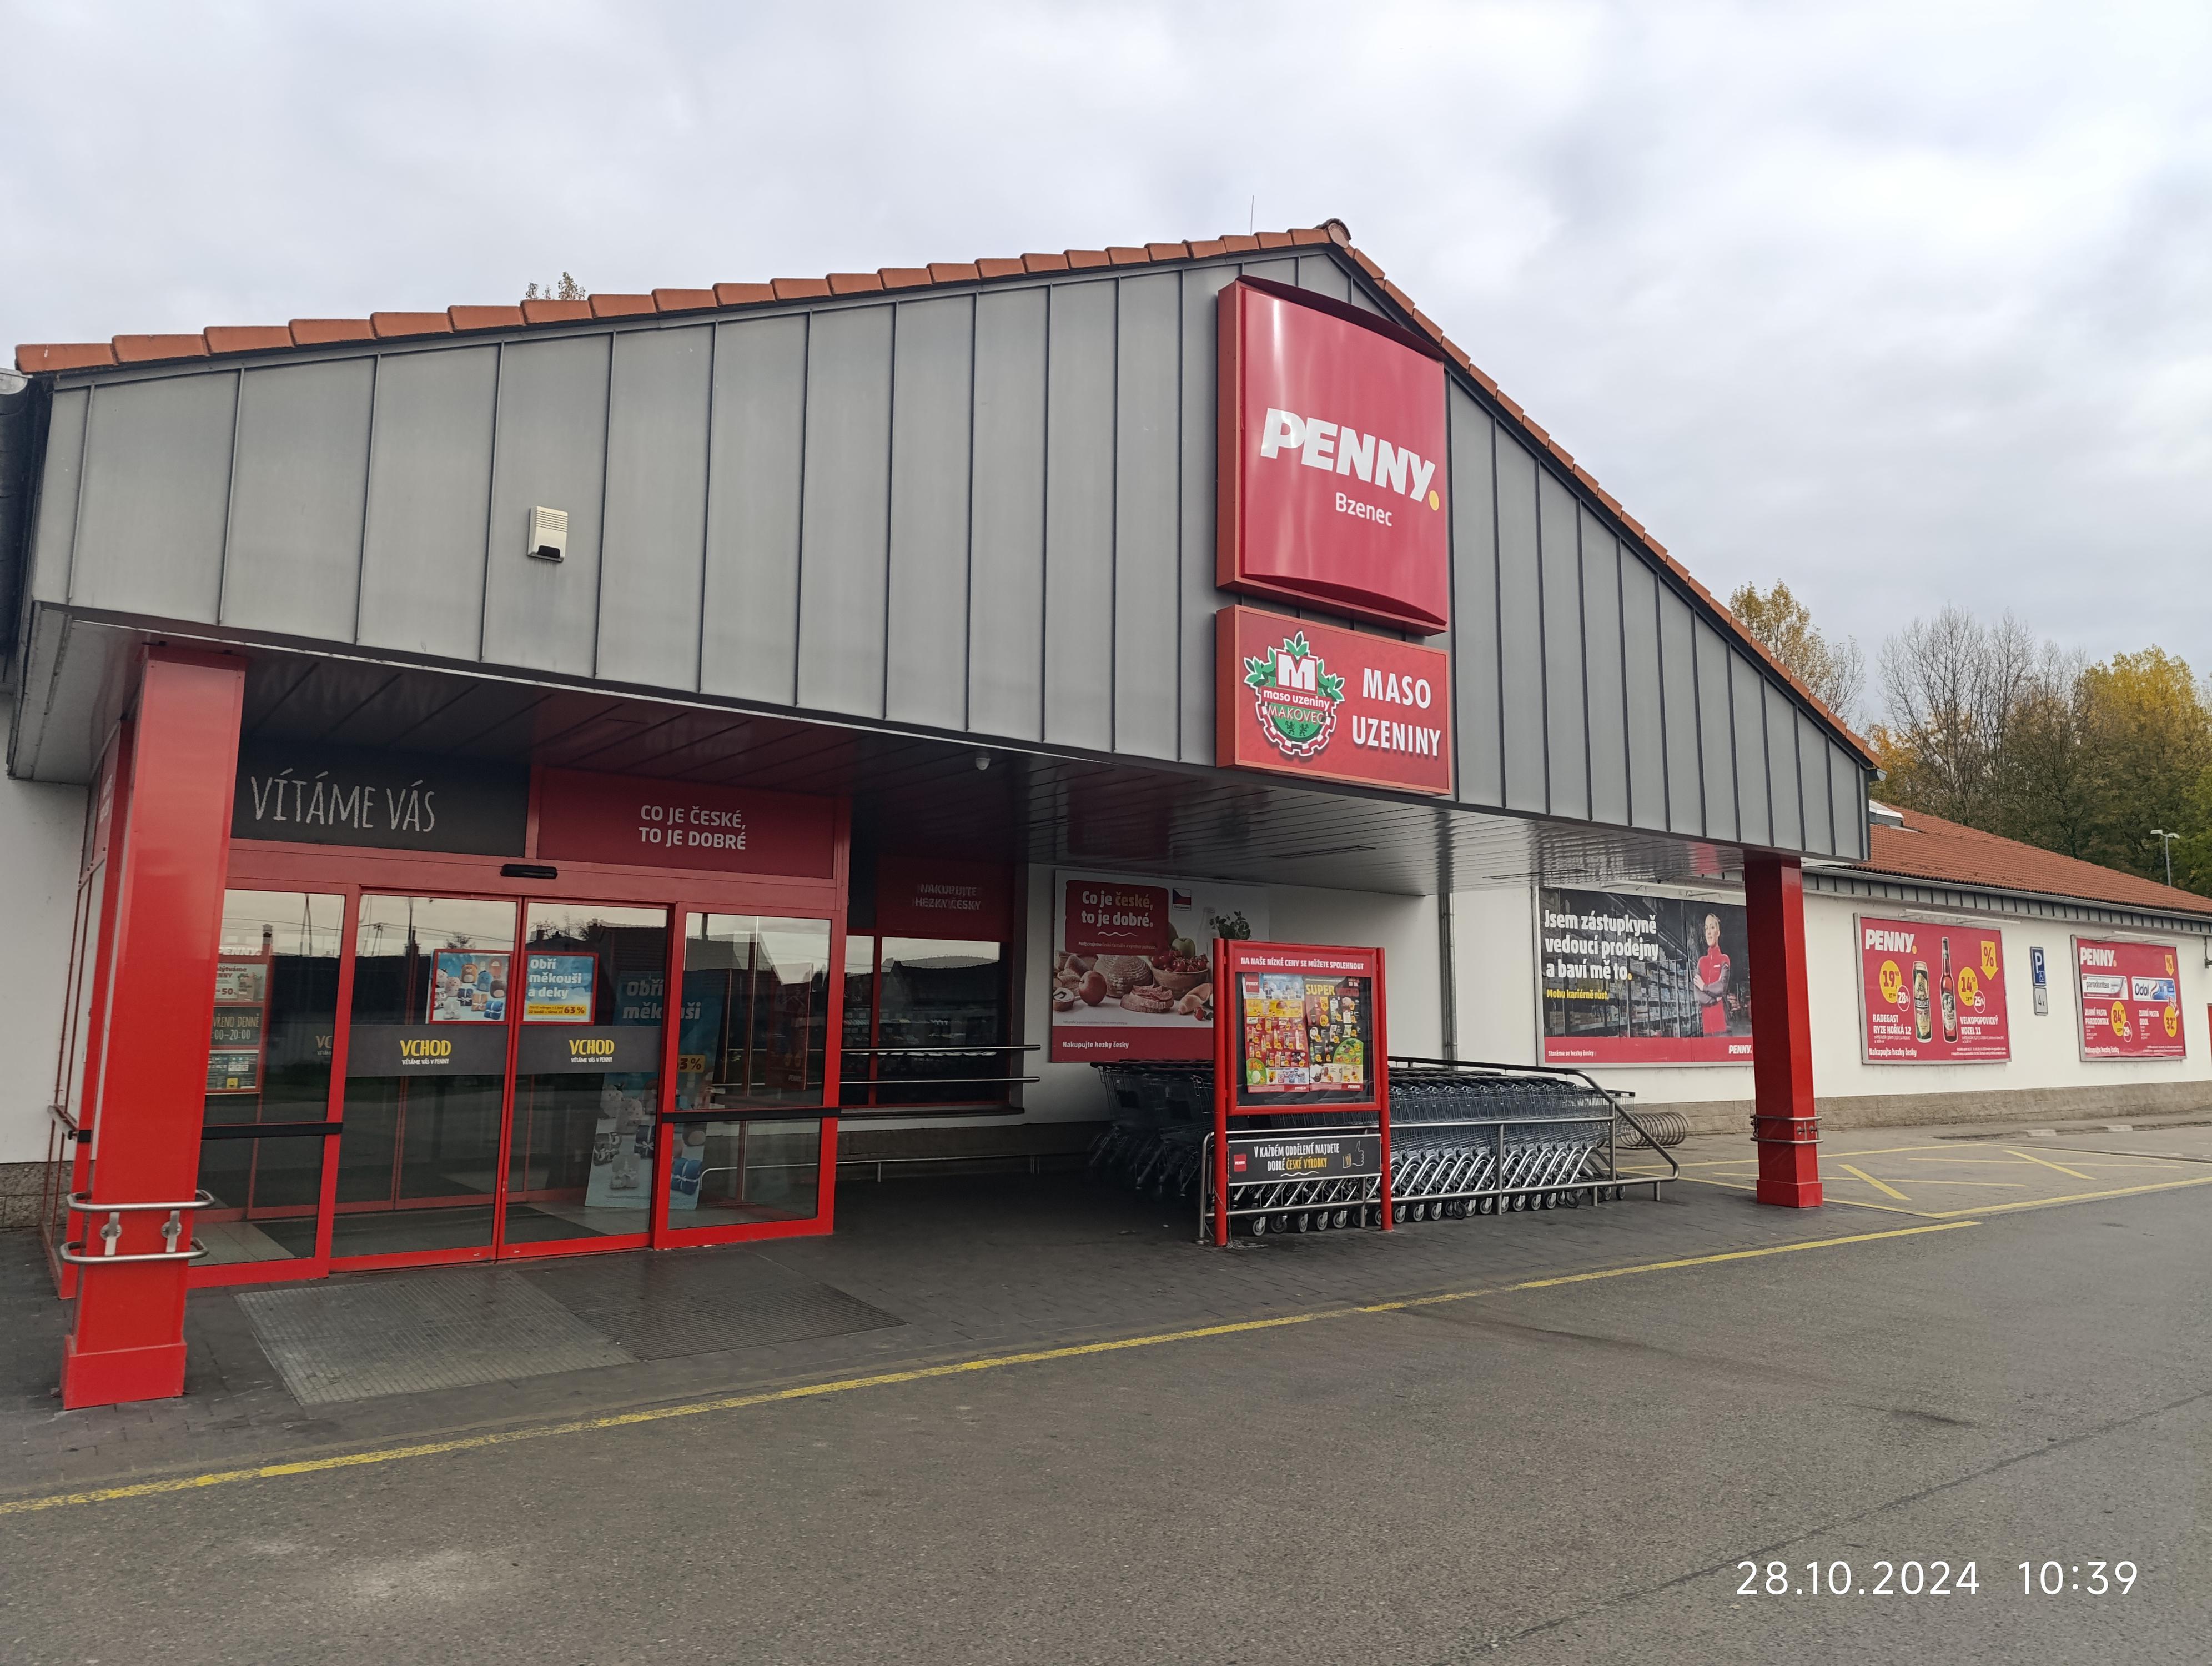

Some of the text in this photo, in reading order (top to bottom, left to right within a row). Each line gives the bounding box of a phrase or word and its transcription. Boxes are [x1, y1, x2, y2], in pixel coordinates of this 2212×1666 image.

[1336, 492, 1392, 526] Bzenec
[1363, 668, 1431, 709] MASO
[1263, 690, 1330, 711] maso uzeniny
[1268, 705, 1325, 724] MAKOVEC
[1352, 715, 1441, 756] UZENINY
[250, 768, 435, 832] VÍTÁME VÁS
[641, 805, 747, 830] CO JE ČESKÉ,
[639, 827, 746, 850] TO JE DOBRÉ
[1083, 890, 1153, 911] Co je české,
[1081, 909, 1153, 927] to je dobré.
[1545, 910, 1657, 937] Jsem zástupkyně
[1545, 934, 1659, 961] vedoucí prodejny
[530, 958, 556, 969] Obří
[1250, 956, 1266, 965] NAŠE
[1267, 956, 1284, 966] NÍZKÉ
[1308, 959, 1329, 968] MŮŽETE
[1546, 959, 1632, 980] a baví mě to.
[529, 972, 582, 983] měkouši
[528, 986, 569, 999] a deky
[626, 979, 664, 996] Obří
[1305, 983, 1335, 996] SUPER
[1546, 989, 1565, 998] Mohu
[1566, 989, 1594, 999] kariérně
[2135, 983, 2149, 996] Odol
[1873, 1013, 1898, 1023] RADEGAST
[1873, 1023, 1912, 1035] RYZE HOŘKÁ 12
[400, 1040, 451, 1056] VCHOD
[569, 1039, 615, 1055] VCHOD
[1062, 1041, 1129, 1050] Nakupujte hezky česky
[1254, 1142, 1340, 1158] V KAŽDÉM ODDĚLENÍ NAJDETE
[1268, 1156, 1328, 1171] DOBRÉ ČESKÉ VÝROBKY
